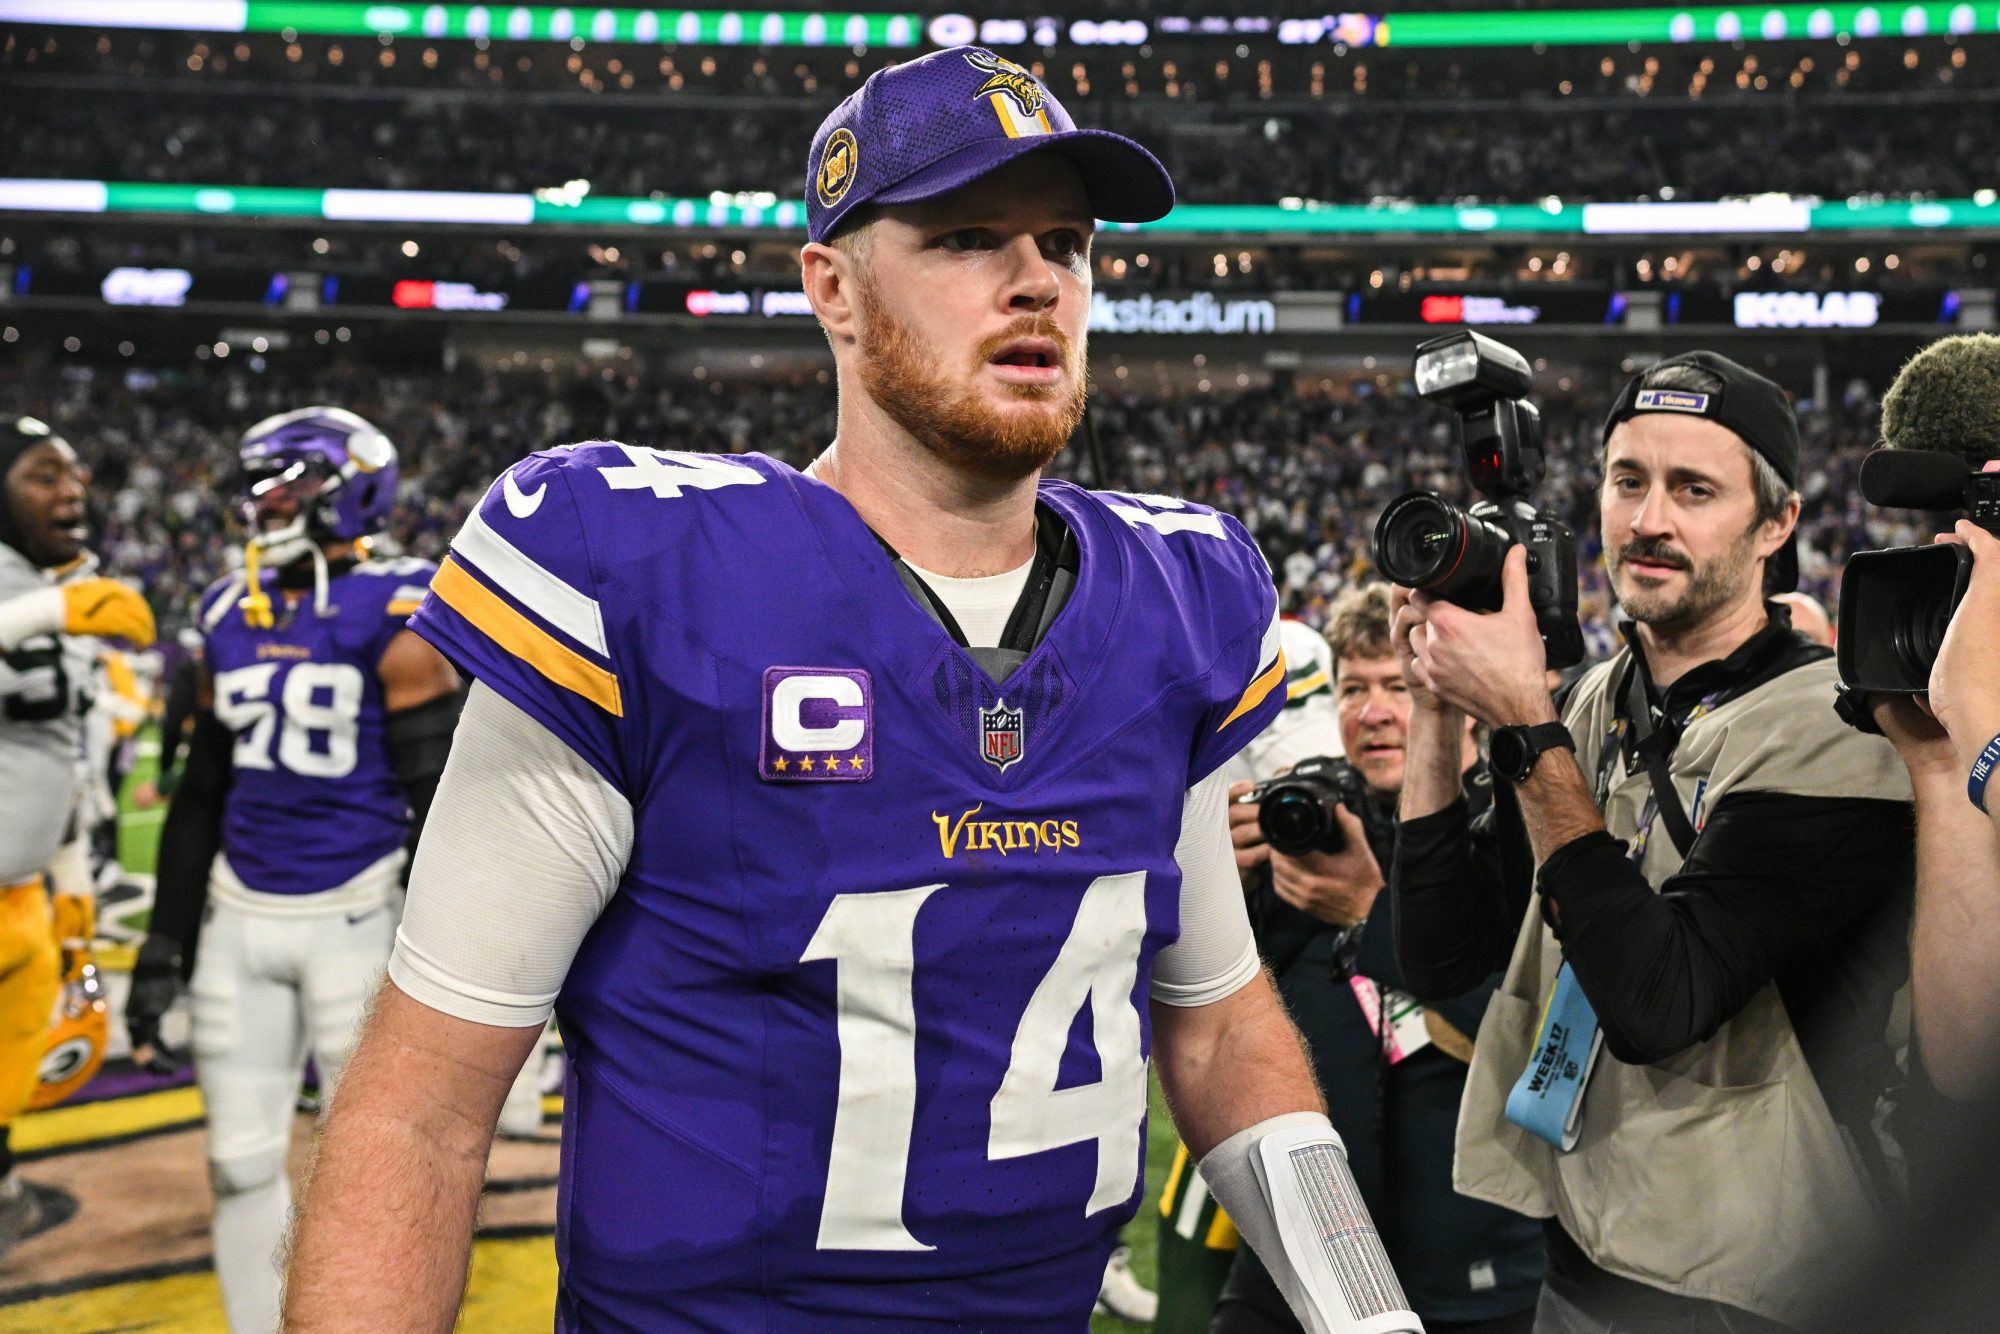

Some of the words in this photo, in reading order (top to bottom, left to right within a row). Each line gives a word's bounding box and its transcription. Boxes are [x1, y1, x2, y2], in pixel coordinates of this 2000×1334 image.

[213, 661, 364, 778] 58
[772, 675, 865, 752] C
[987, 732, 1018, 759] NFL
[1972, 758, 1990, 782] THE
[1984, 745, 2000, 761] 11
[799, 870, 1149, 1251] 14
[1528, 1042, 1559, 1092] WEEK
[1550, 1022, 1563, 1042] 17
